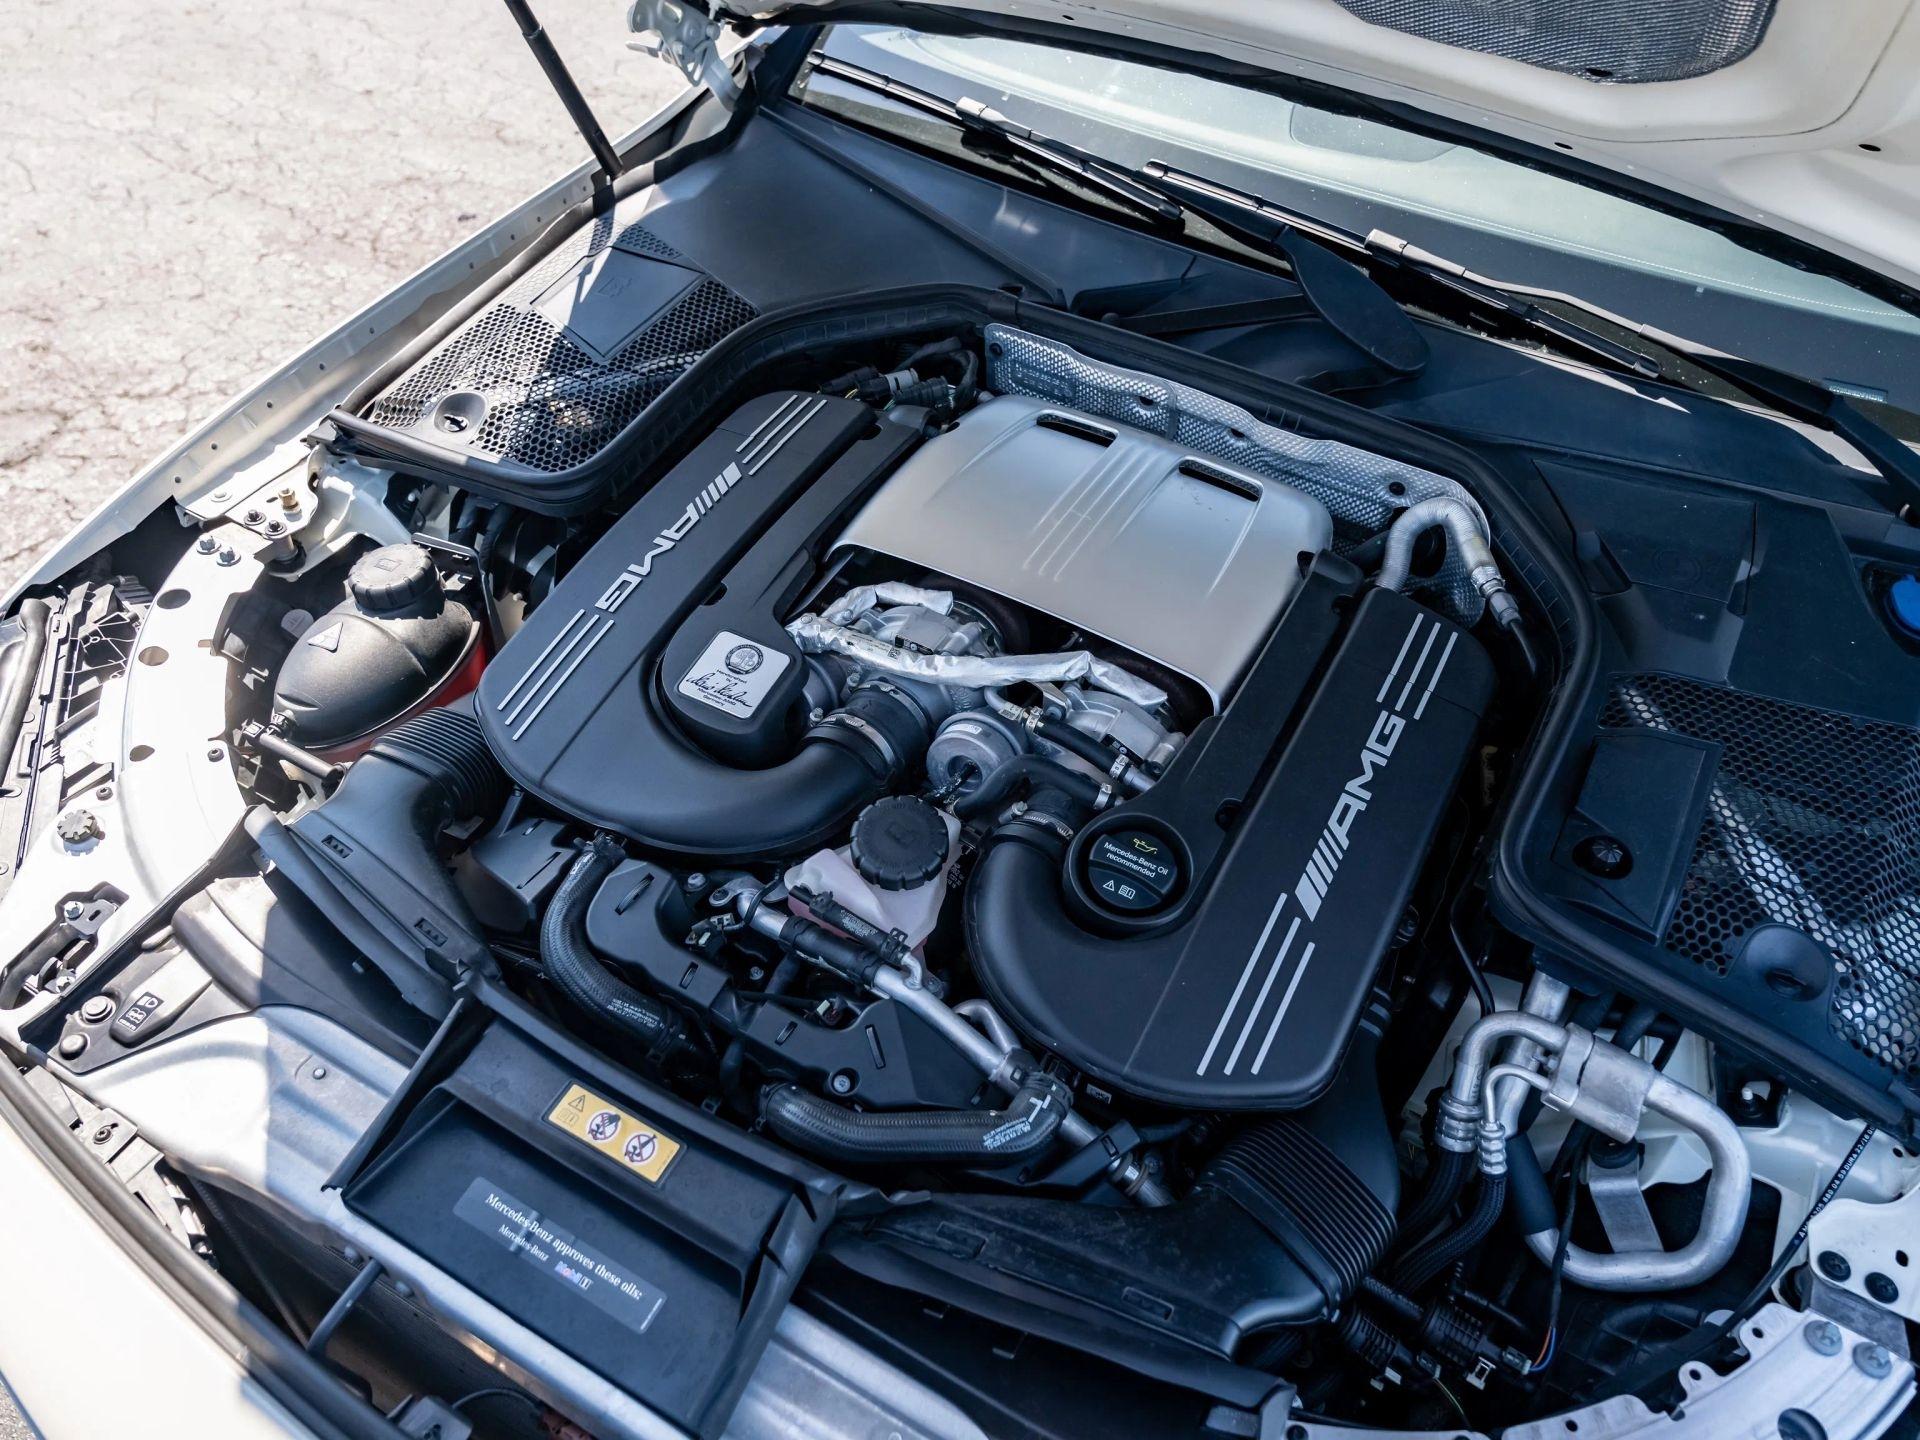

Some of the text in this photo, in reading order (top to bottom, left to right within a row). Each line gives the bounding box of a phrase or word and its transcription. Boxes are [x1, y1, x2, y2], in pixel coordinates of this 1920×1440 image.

[1104, 841, 1169, 876] Mercedes-Benz Oil
[1106, 852, 1156, 878] recommended
[485, 1193, 643, 1301] Mercedes-Benz approves these oils:
[498, 1224, 549, 1262] Mercedes-Benz
